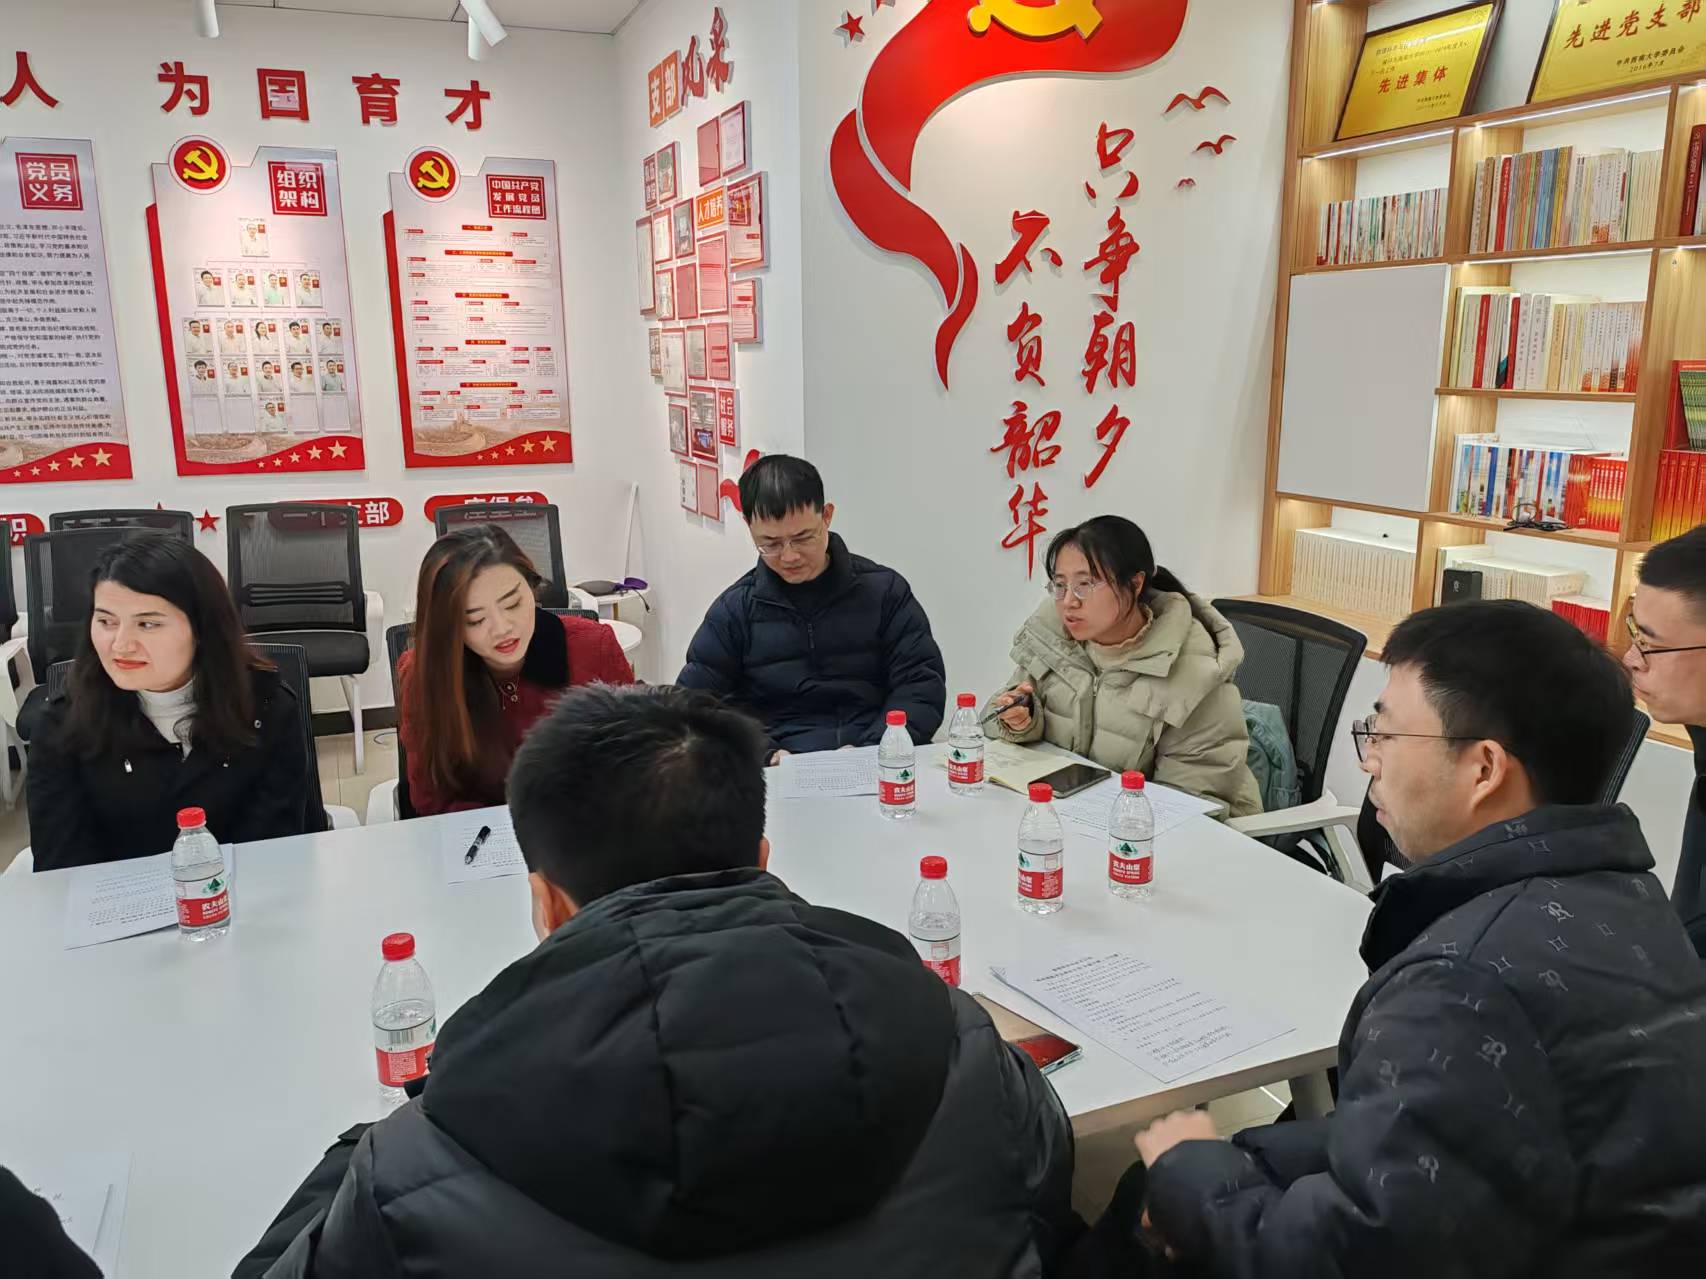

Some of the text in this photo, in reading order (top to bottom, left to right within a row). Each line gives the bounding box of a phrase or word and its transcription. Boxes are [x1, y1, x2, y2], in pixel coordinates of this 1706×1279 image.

[1564, 0, 1700, 49] 先进党支部
[1378, 65, 1448, 94] 先进集体
[26, 162, 71, 180] 党员
[277, 170, 318, 189] 组织
[29, 183, 73, 202] 义务
[492, 180, 540, 191] 中国共产党
[279, 189, 319, 208] 架构
[492, 192, 540, 203] 发展党员
[493, 204, 541, 214] 工作流程图
[1082, 122, 1140, 489] 只争朝夕
[991, 209, 1063, 582] 不负韶华
